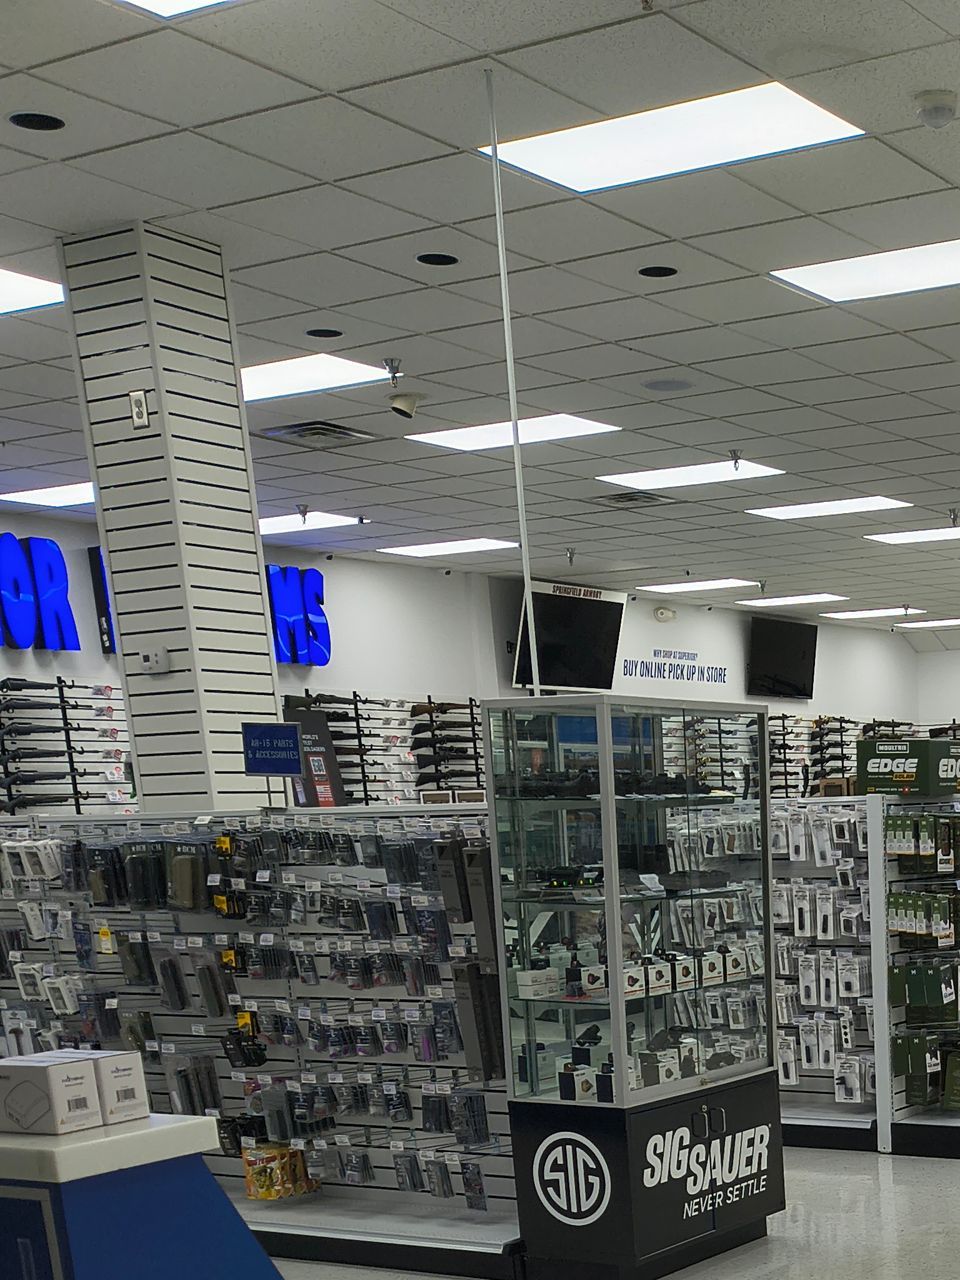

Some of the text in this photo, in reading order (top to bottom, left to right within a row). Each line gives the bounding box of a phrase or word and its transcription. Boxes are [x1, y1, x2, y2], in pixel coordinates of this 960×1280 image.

[0, 531, 81, 651] OR
[552, 584, 602, 599] SPRINGFIELD ARMORY
[653, 649, 662, 658] WHY
[662, 650, 673, 659] SHOP
[623, 659, 727, 684] BUY ONLINE PICK UP IN STORE
[250, 738, 294, 748] AR-15 PARTS
[255, 750, 299, 760] ACCESSORIES
[867, 758, 919, 773] EDGE
[643, 1124, 770, 1196] SIG SAUER
[543, 1143, 600, 1213] SIG
[683, 1174, 767, 1220] NEVER SETTLE
